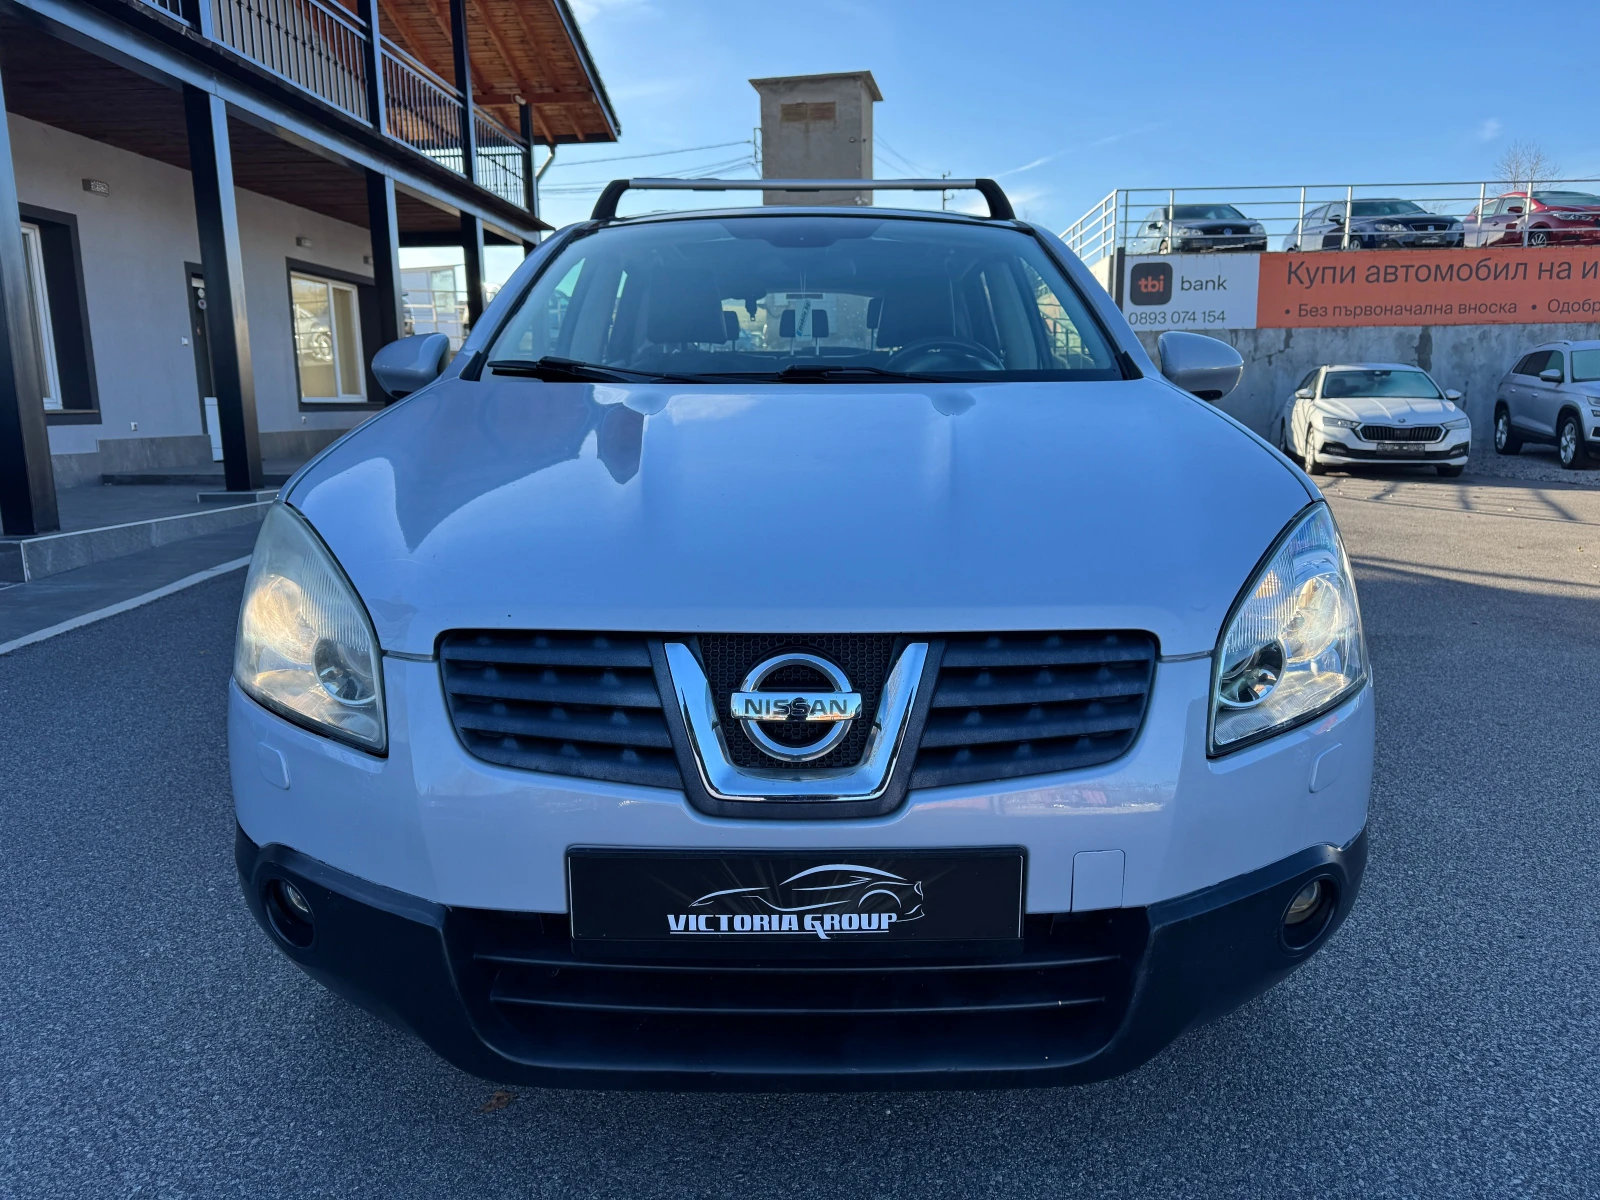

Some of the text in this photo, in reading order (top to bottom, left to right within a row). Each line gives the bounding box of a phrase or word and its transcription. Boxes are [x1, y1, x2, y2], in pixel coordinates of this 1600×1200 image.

[1287, 256, 1599, 290] Купи автомобил на и
[1138, 274, 1228, 293] tbi bank
[1128, 310, 1227, 326] 0893 074 154
[1298, 298, 1600, 319] Без първоначална вноска Одобр
[744, 698, 848, 716] NISSAN
[667, 912, 898, 940] VICTORIA GROUP
